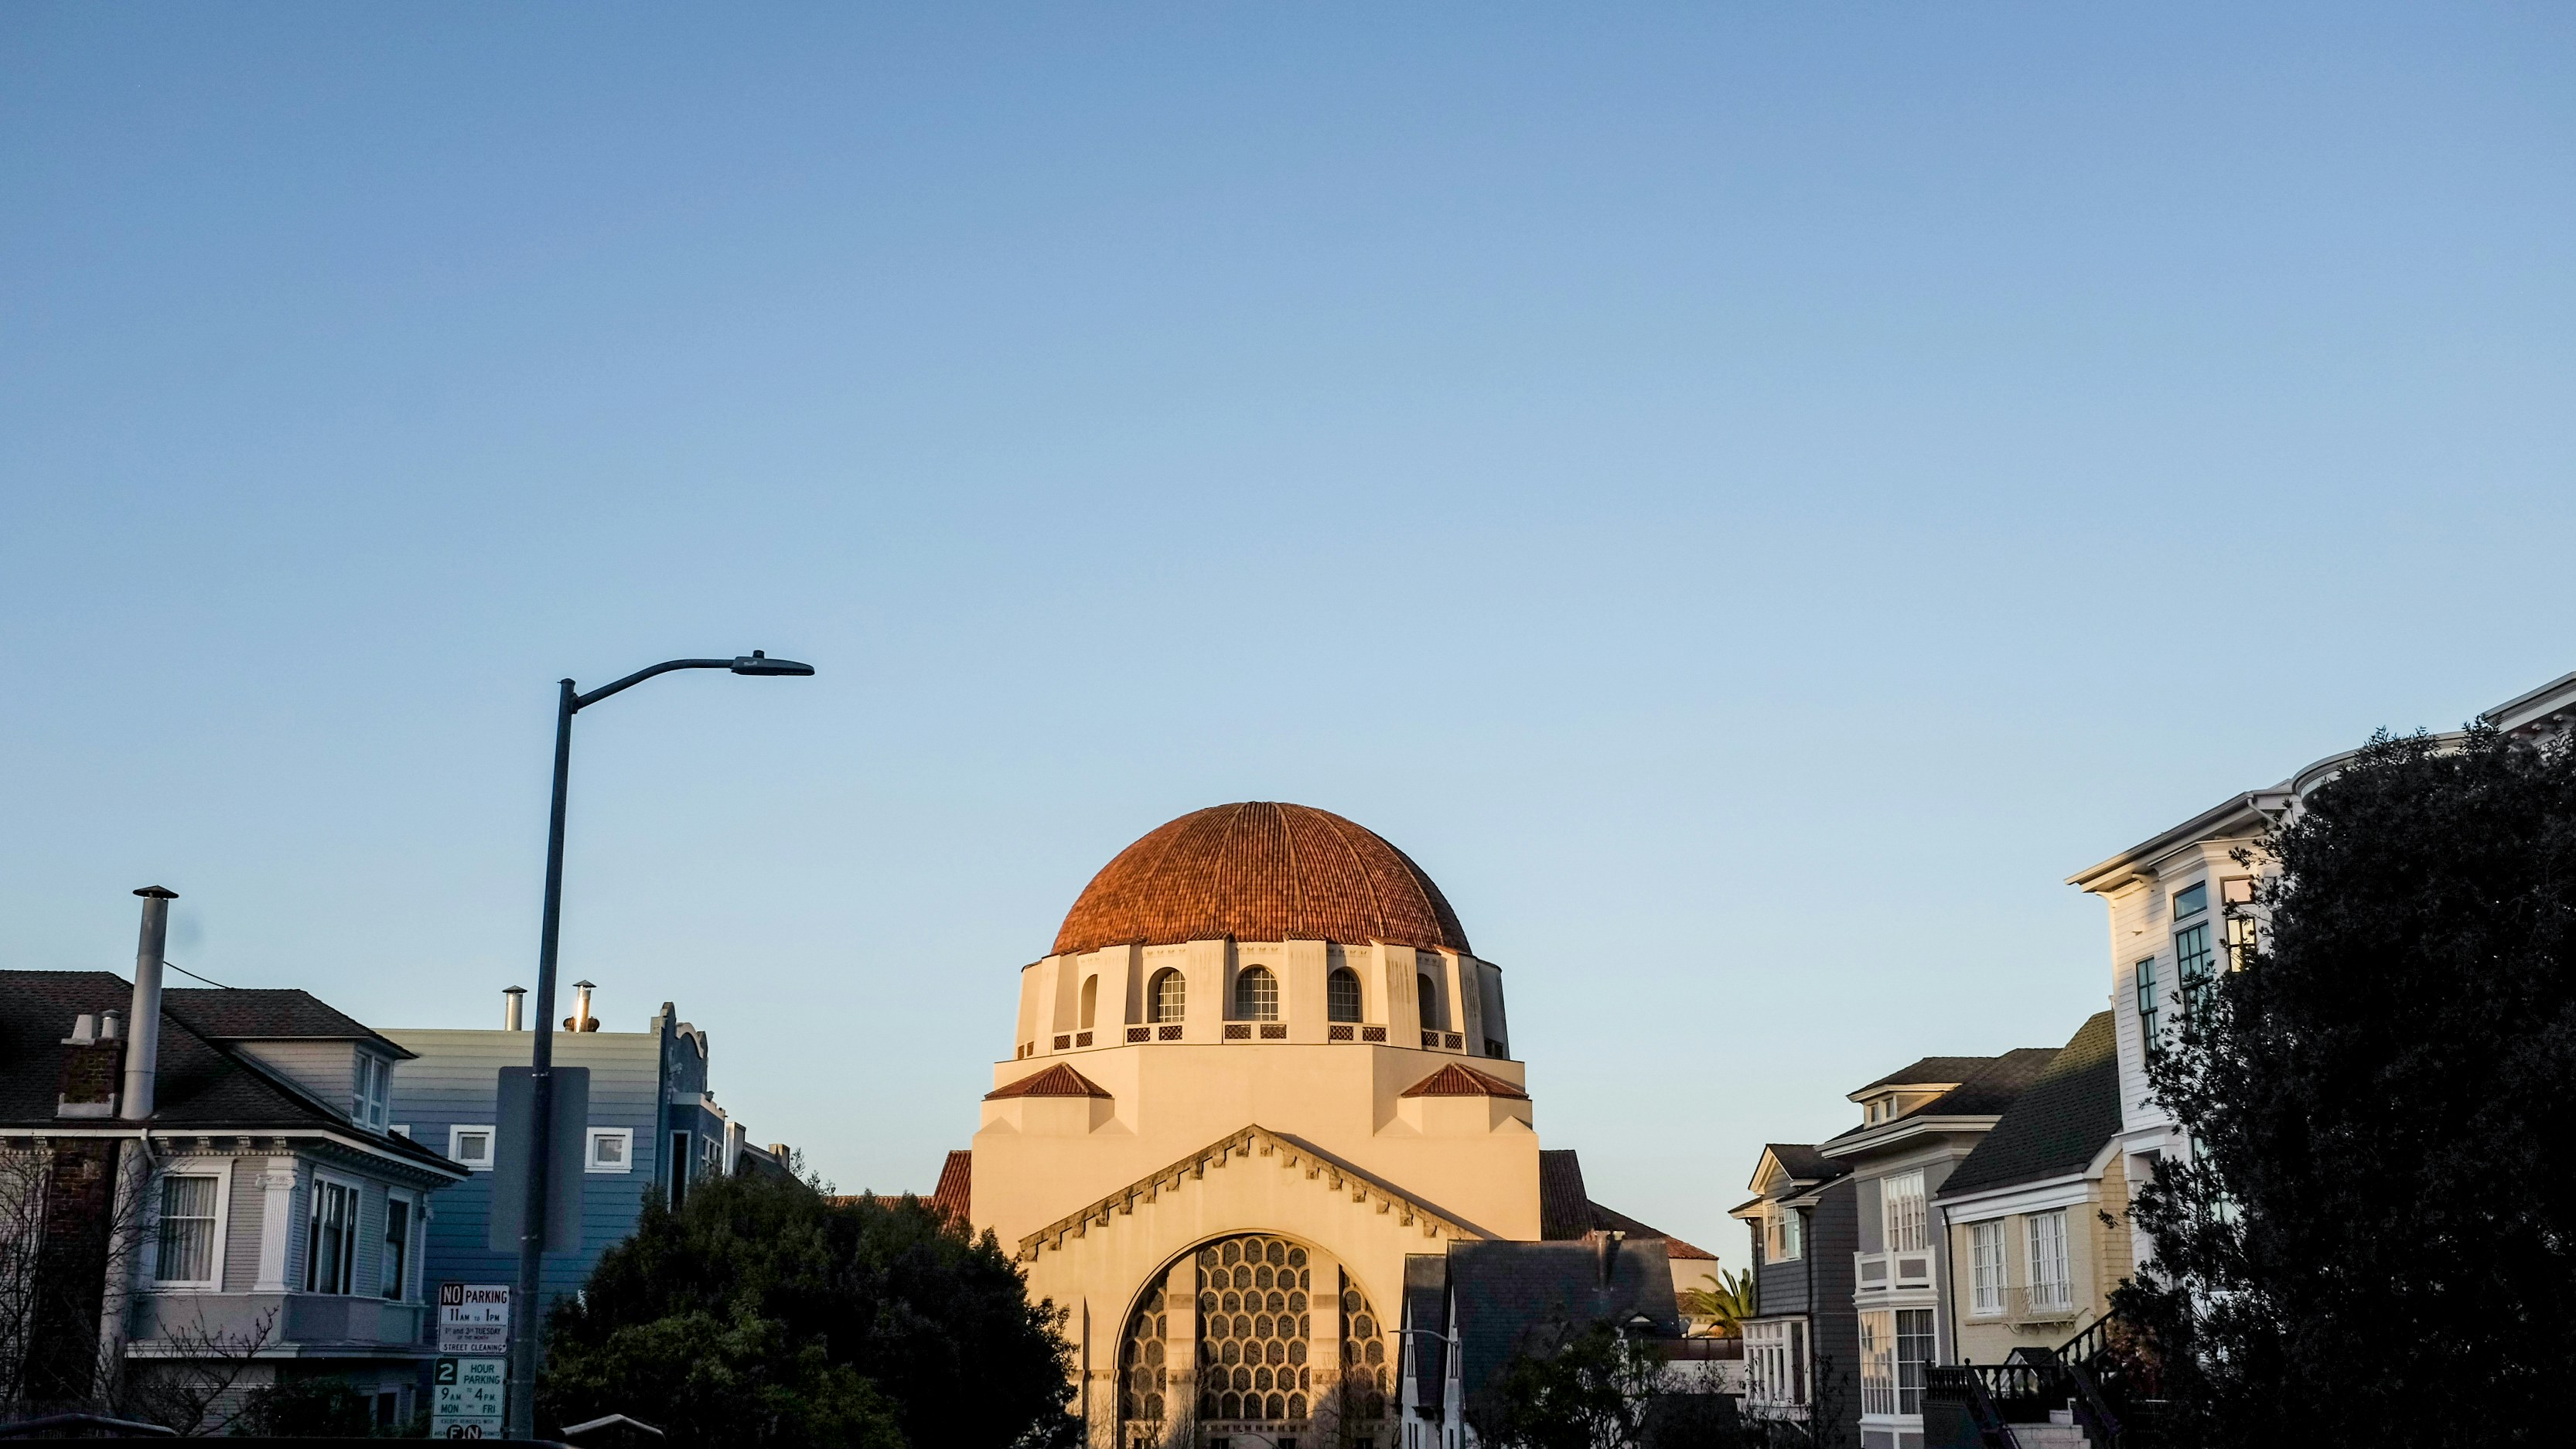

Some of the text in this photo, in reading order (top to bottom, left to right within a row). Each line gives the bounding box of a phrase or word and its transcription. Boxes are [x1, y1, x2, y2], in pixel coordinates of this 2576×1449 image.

[444, 1286, 507, 1304] NO PARKING
[438, 1362, 494, 1380] 2 HOUR
[464, 1376, 500, 1384] PARKING
[441, 1404, 459, 1413] MON
[483, 1405, 496, 1413] FRI
